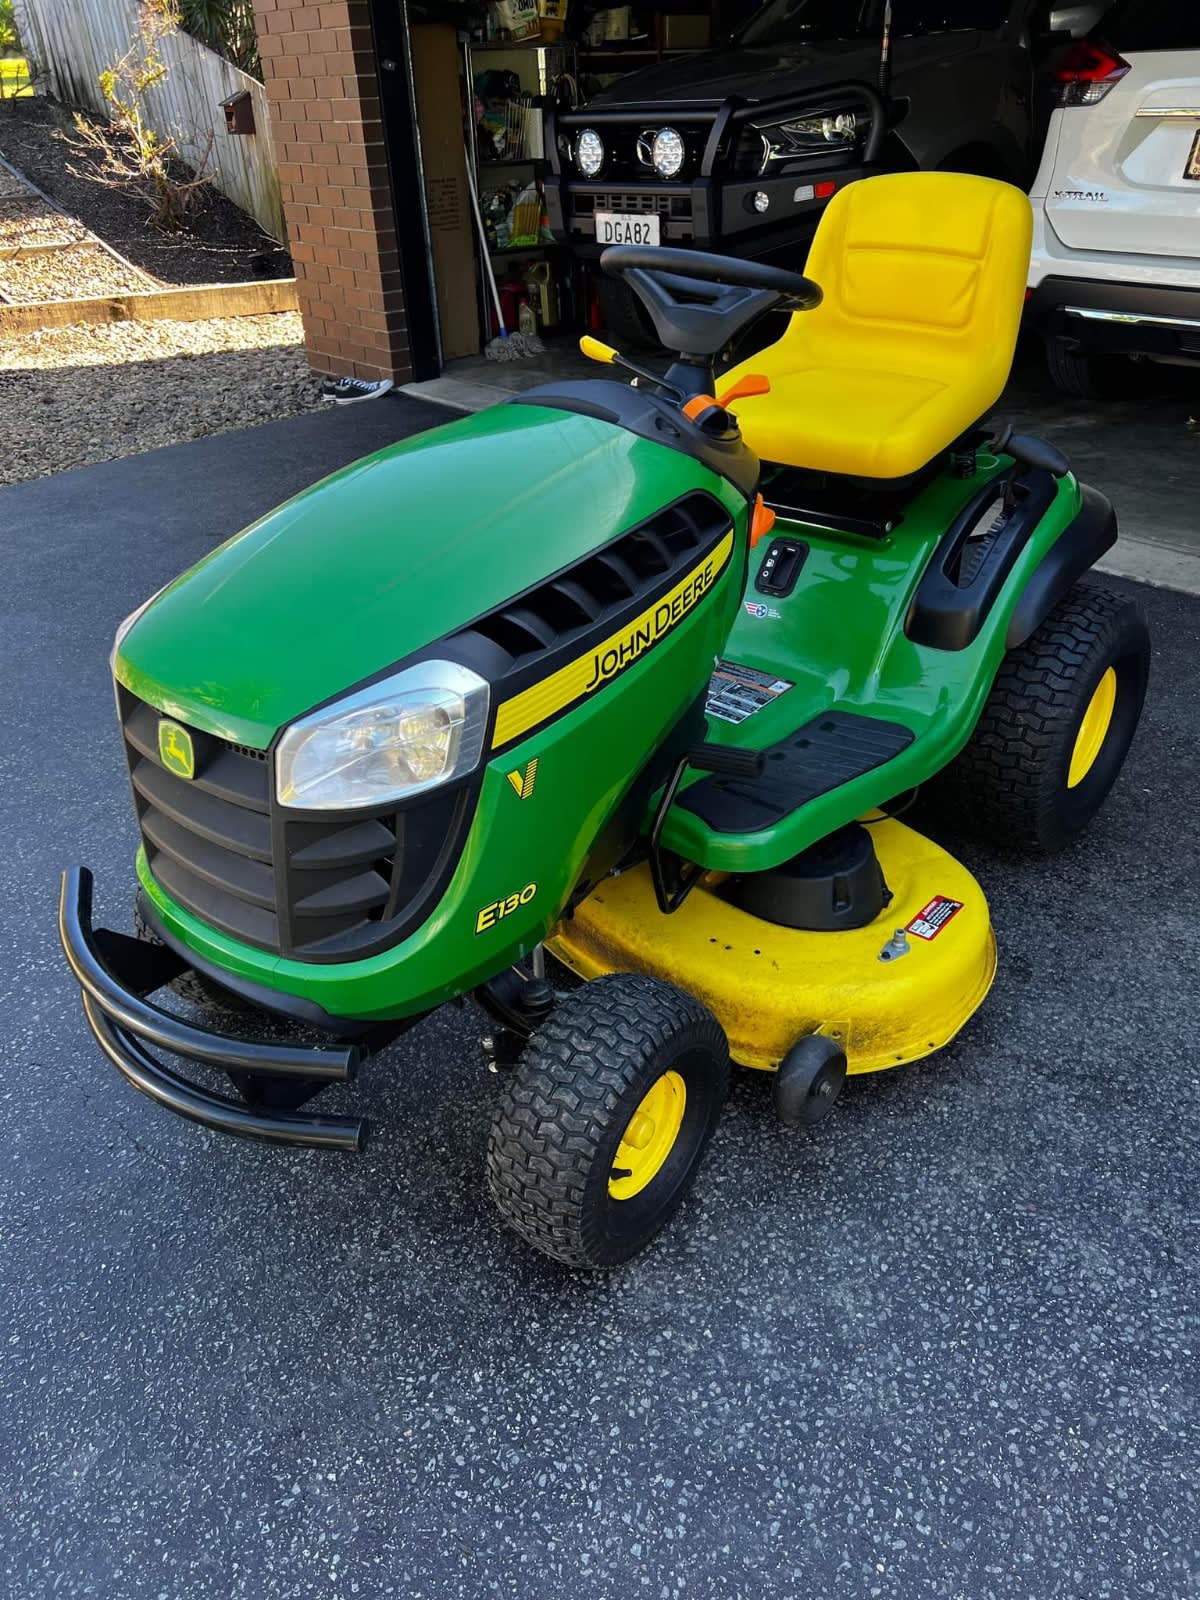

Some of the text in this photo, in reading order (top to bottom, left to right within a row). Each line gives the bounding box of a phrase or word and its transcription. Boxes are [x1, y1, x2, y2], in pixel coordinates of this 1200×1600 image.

[1053, 190, 1109, 202] X-TRAIL
[604, 220, 651, 245] DGA82
[585, 560, 714, 690] JOHN DEERE
[475, 882, 538, 934] E130
